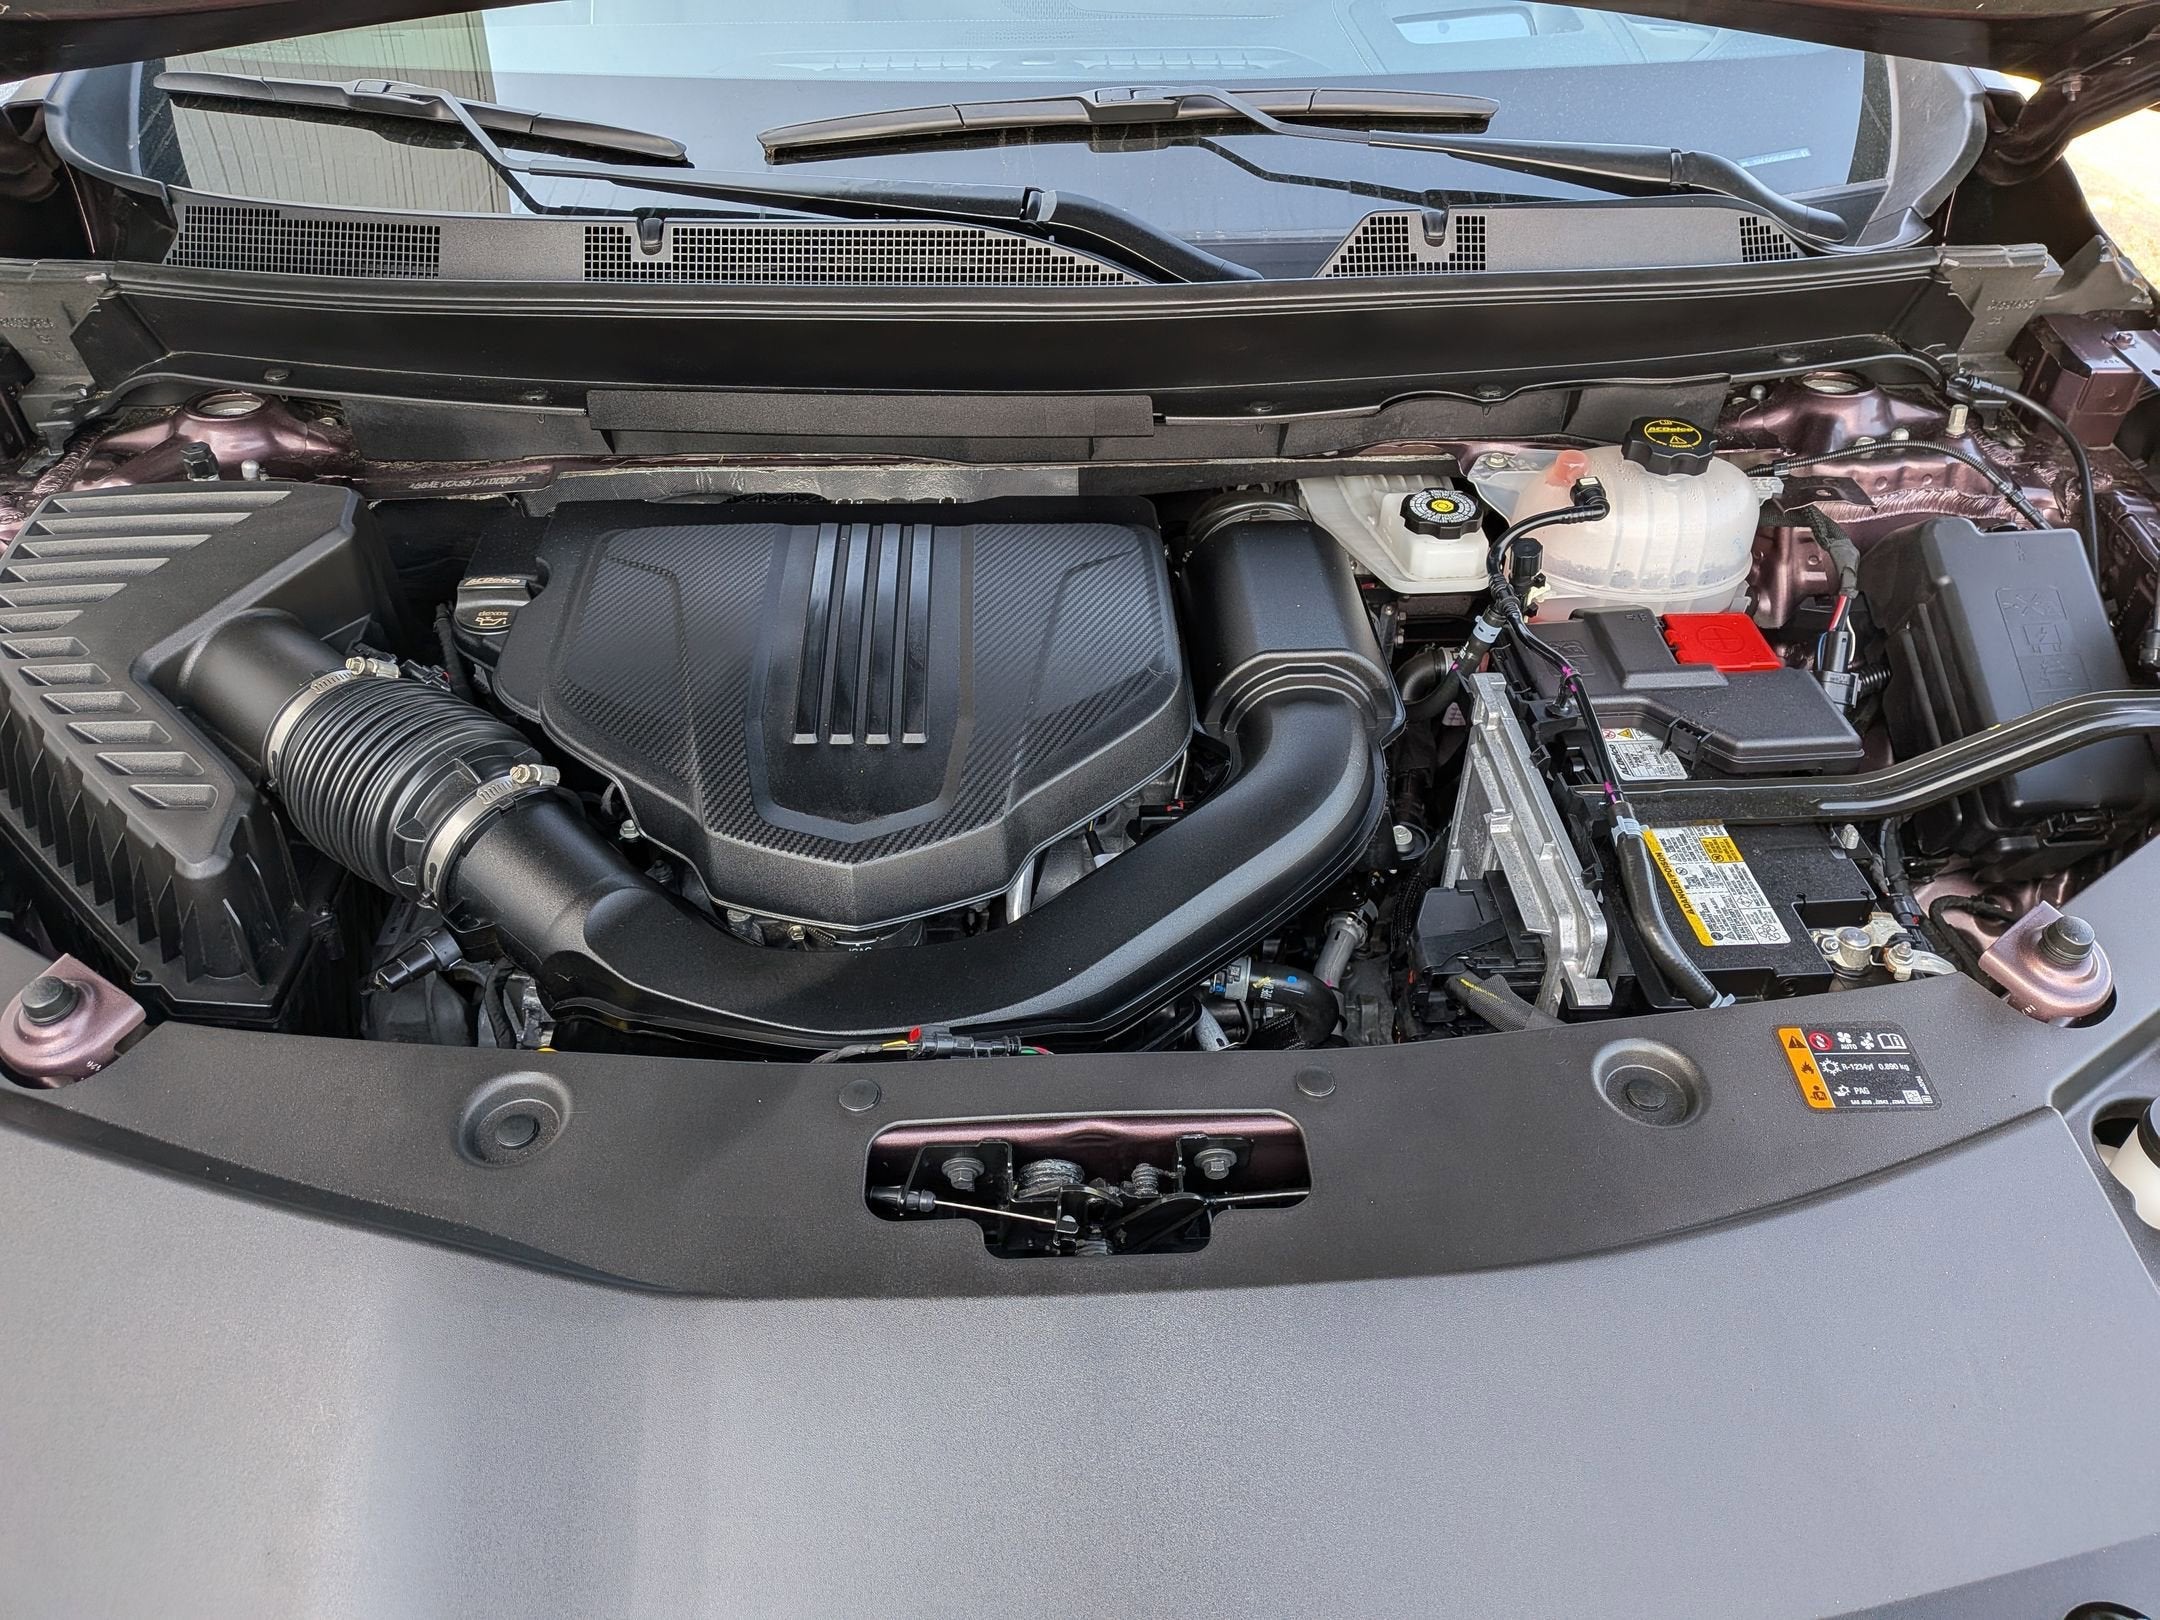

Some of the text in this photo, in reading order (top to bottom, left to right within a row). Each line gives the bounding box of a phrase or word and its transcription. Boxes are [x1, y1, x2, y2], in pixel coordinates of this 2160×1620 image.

[464, 577, 521, 587] ACDelco
[1609, 744, 1631, 776] ACDelco
[1654, 851, 1694, 910] DANGER/POISON
[1898, 1062, 1910, 1072] kg
[1853, 1086, 1871, 1095] PAG
